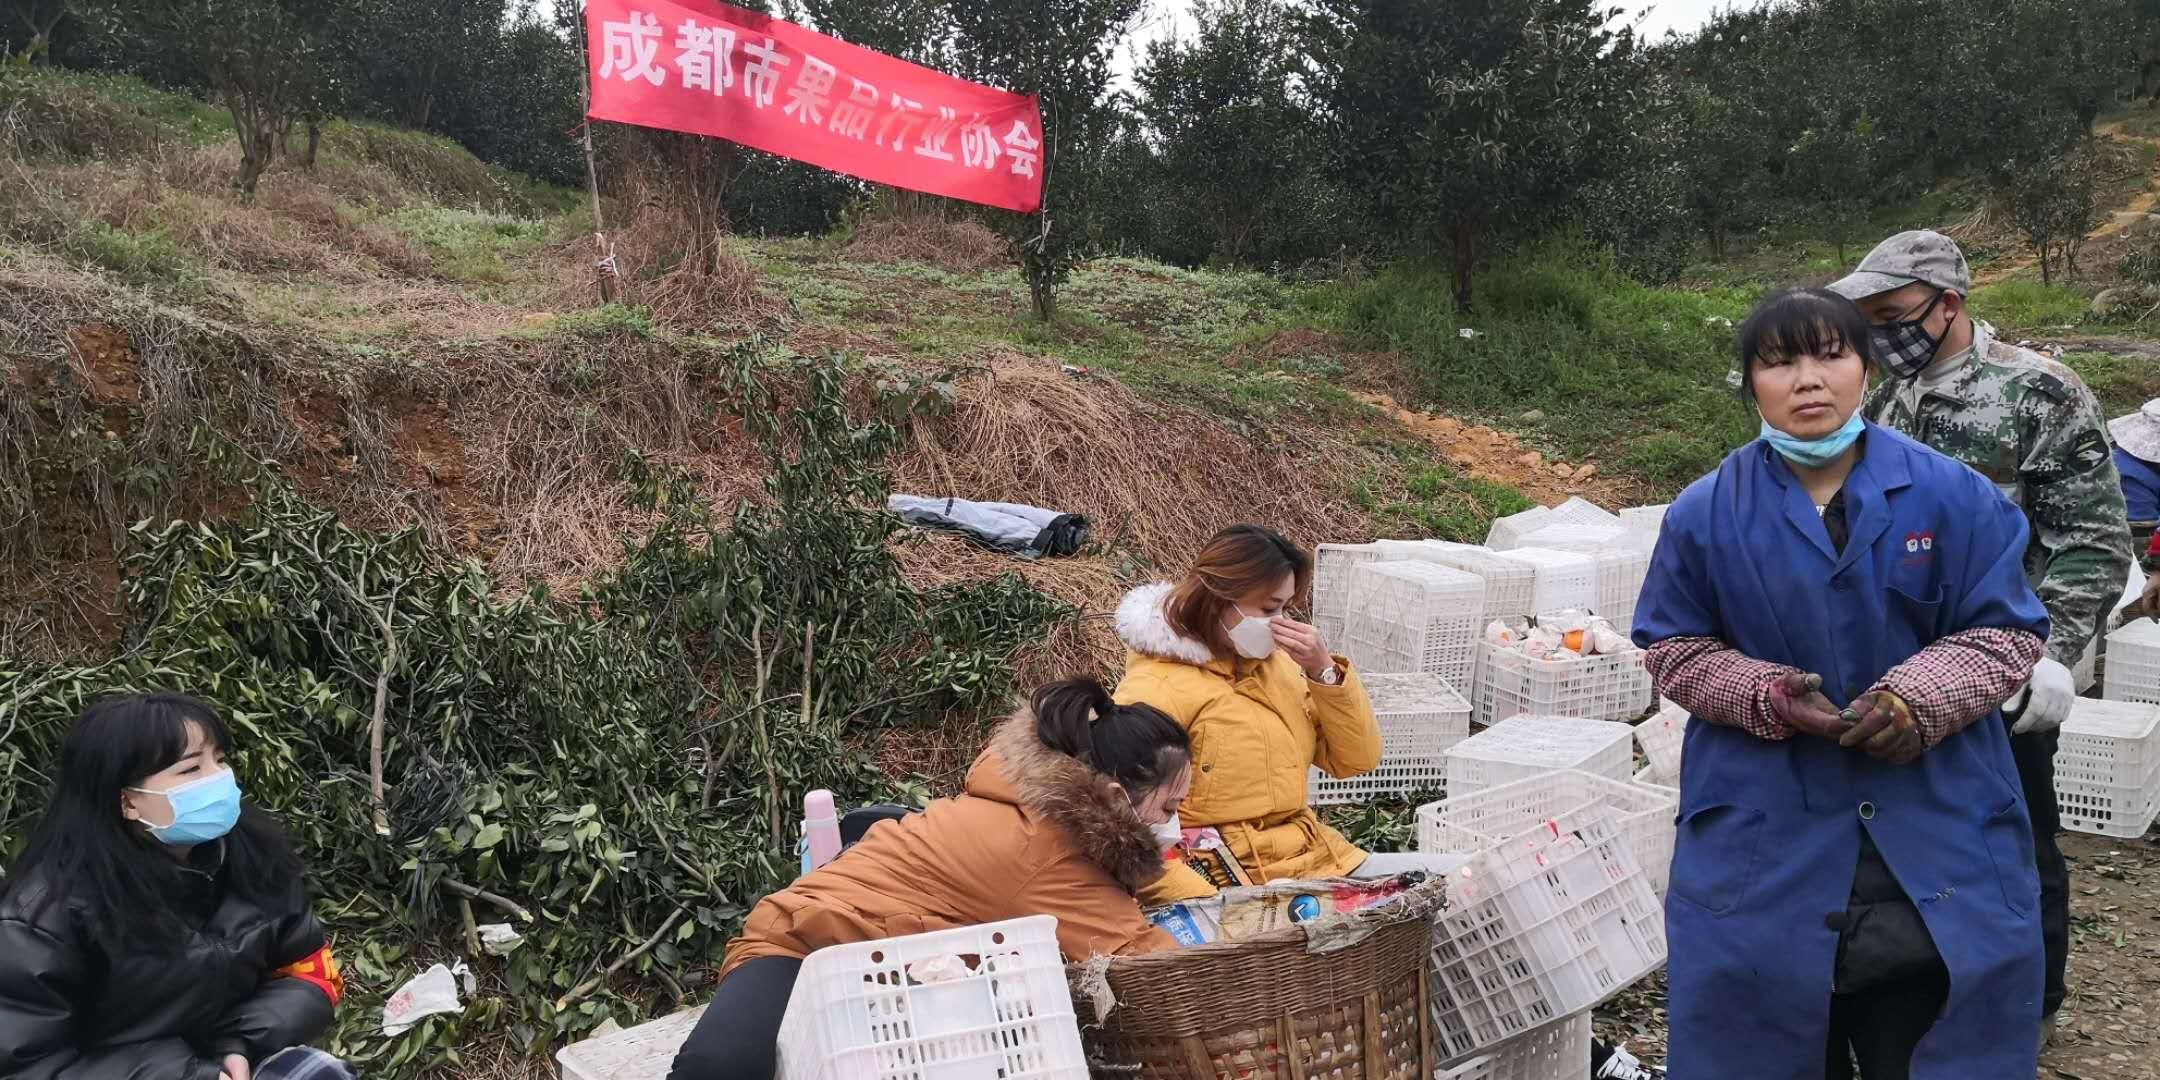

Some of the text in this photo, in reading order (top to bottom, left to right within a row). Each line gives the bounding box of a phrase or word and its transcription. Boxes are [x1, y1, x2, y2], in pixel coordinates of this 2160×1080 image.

[598, 10, 1040, 180] 成都市果品行业协会
